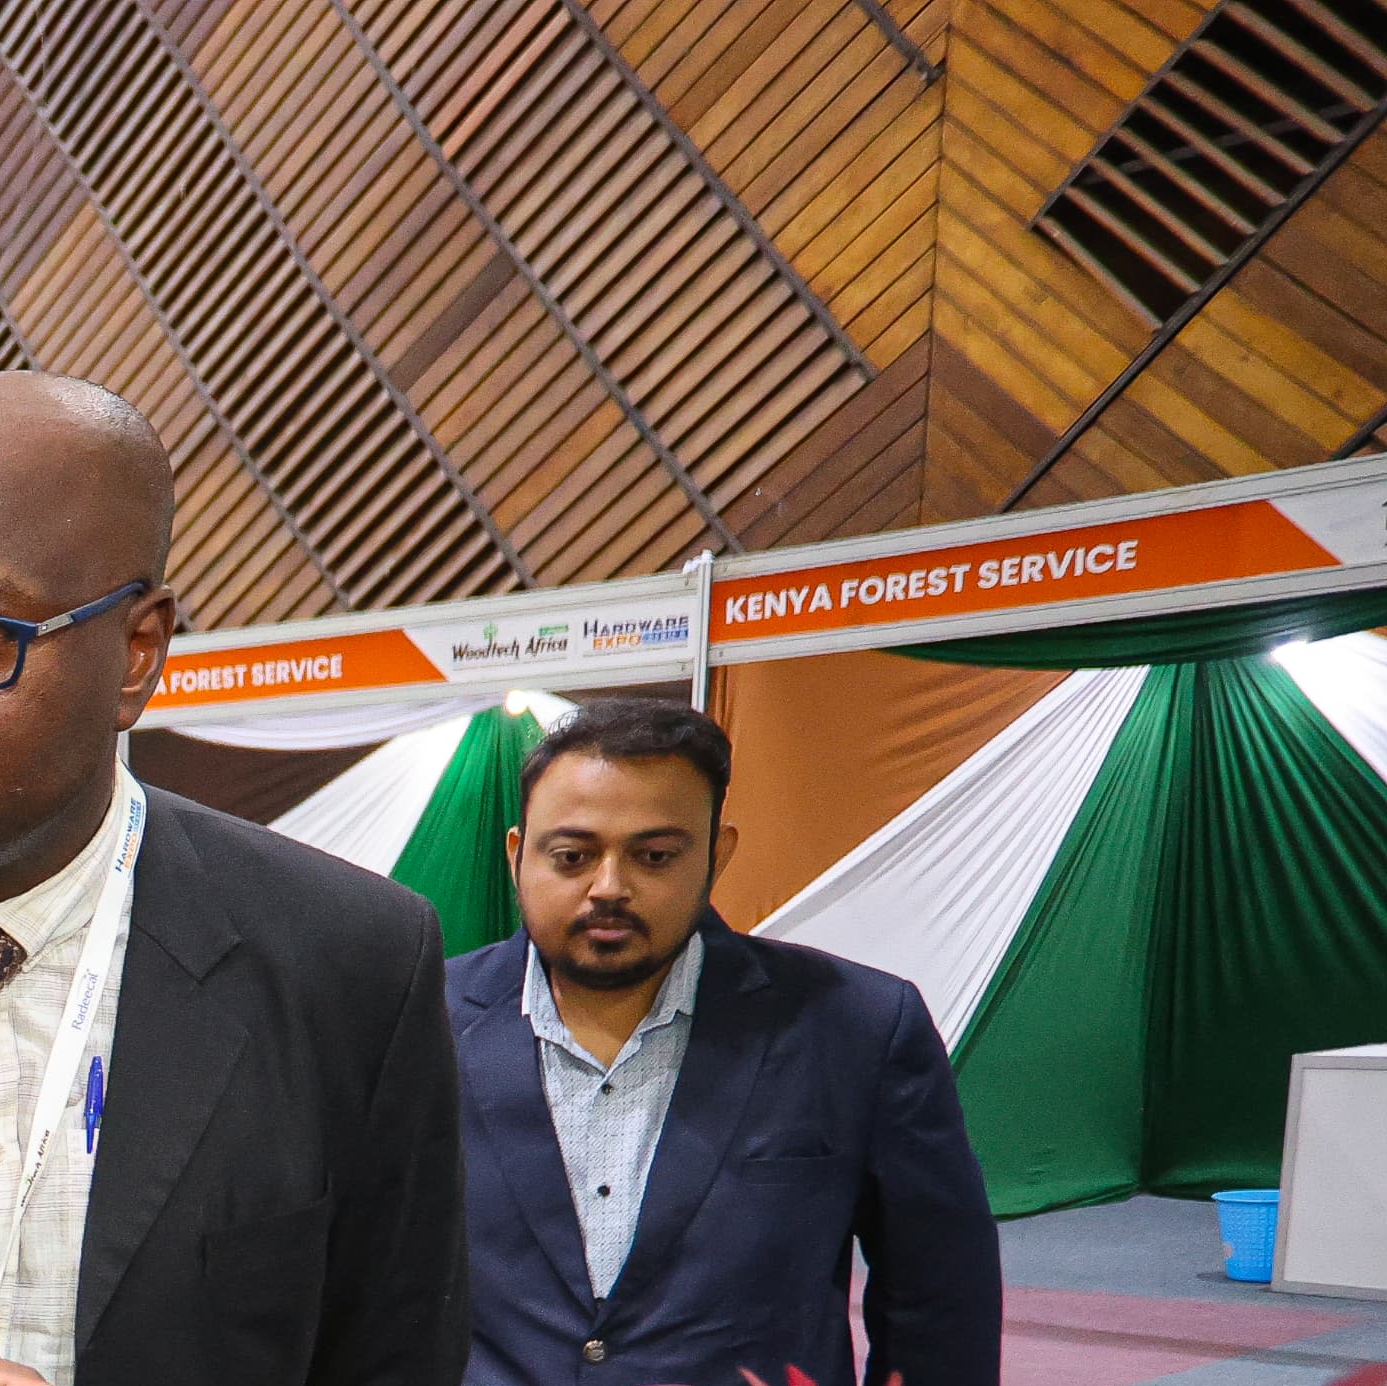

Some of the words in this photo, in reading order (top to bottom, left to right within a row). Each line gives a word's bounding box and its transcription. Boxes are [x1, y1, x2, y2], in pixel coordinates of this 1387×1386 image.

[725, 582, 833, 625] KENYA
[839, 563, 966, 608] FOREST
[978, 541, 1138, 588] SERVICE
[170, 660, 247, 693] FOREST
[250, 652, 343, 686] SERVICE
[453, 637, 520, 661] Woodtech
[525, 635, 569, 656] Africa
[71, 971, 99, 1031] Radeecal
